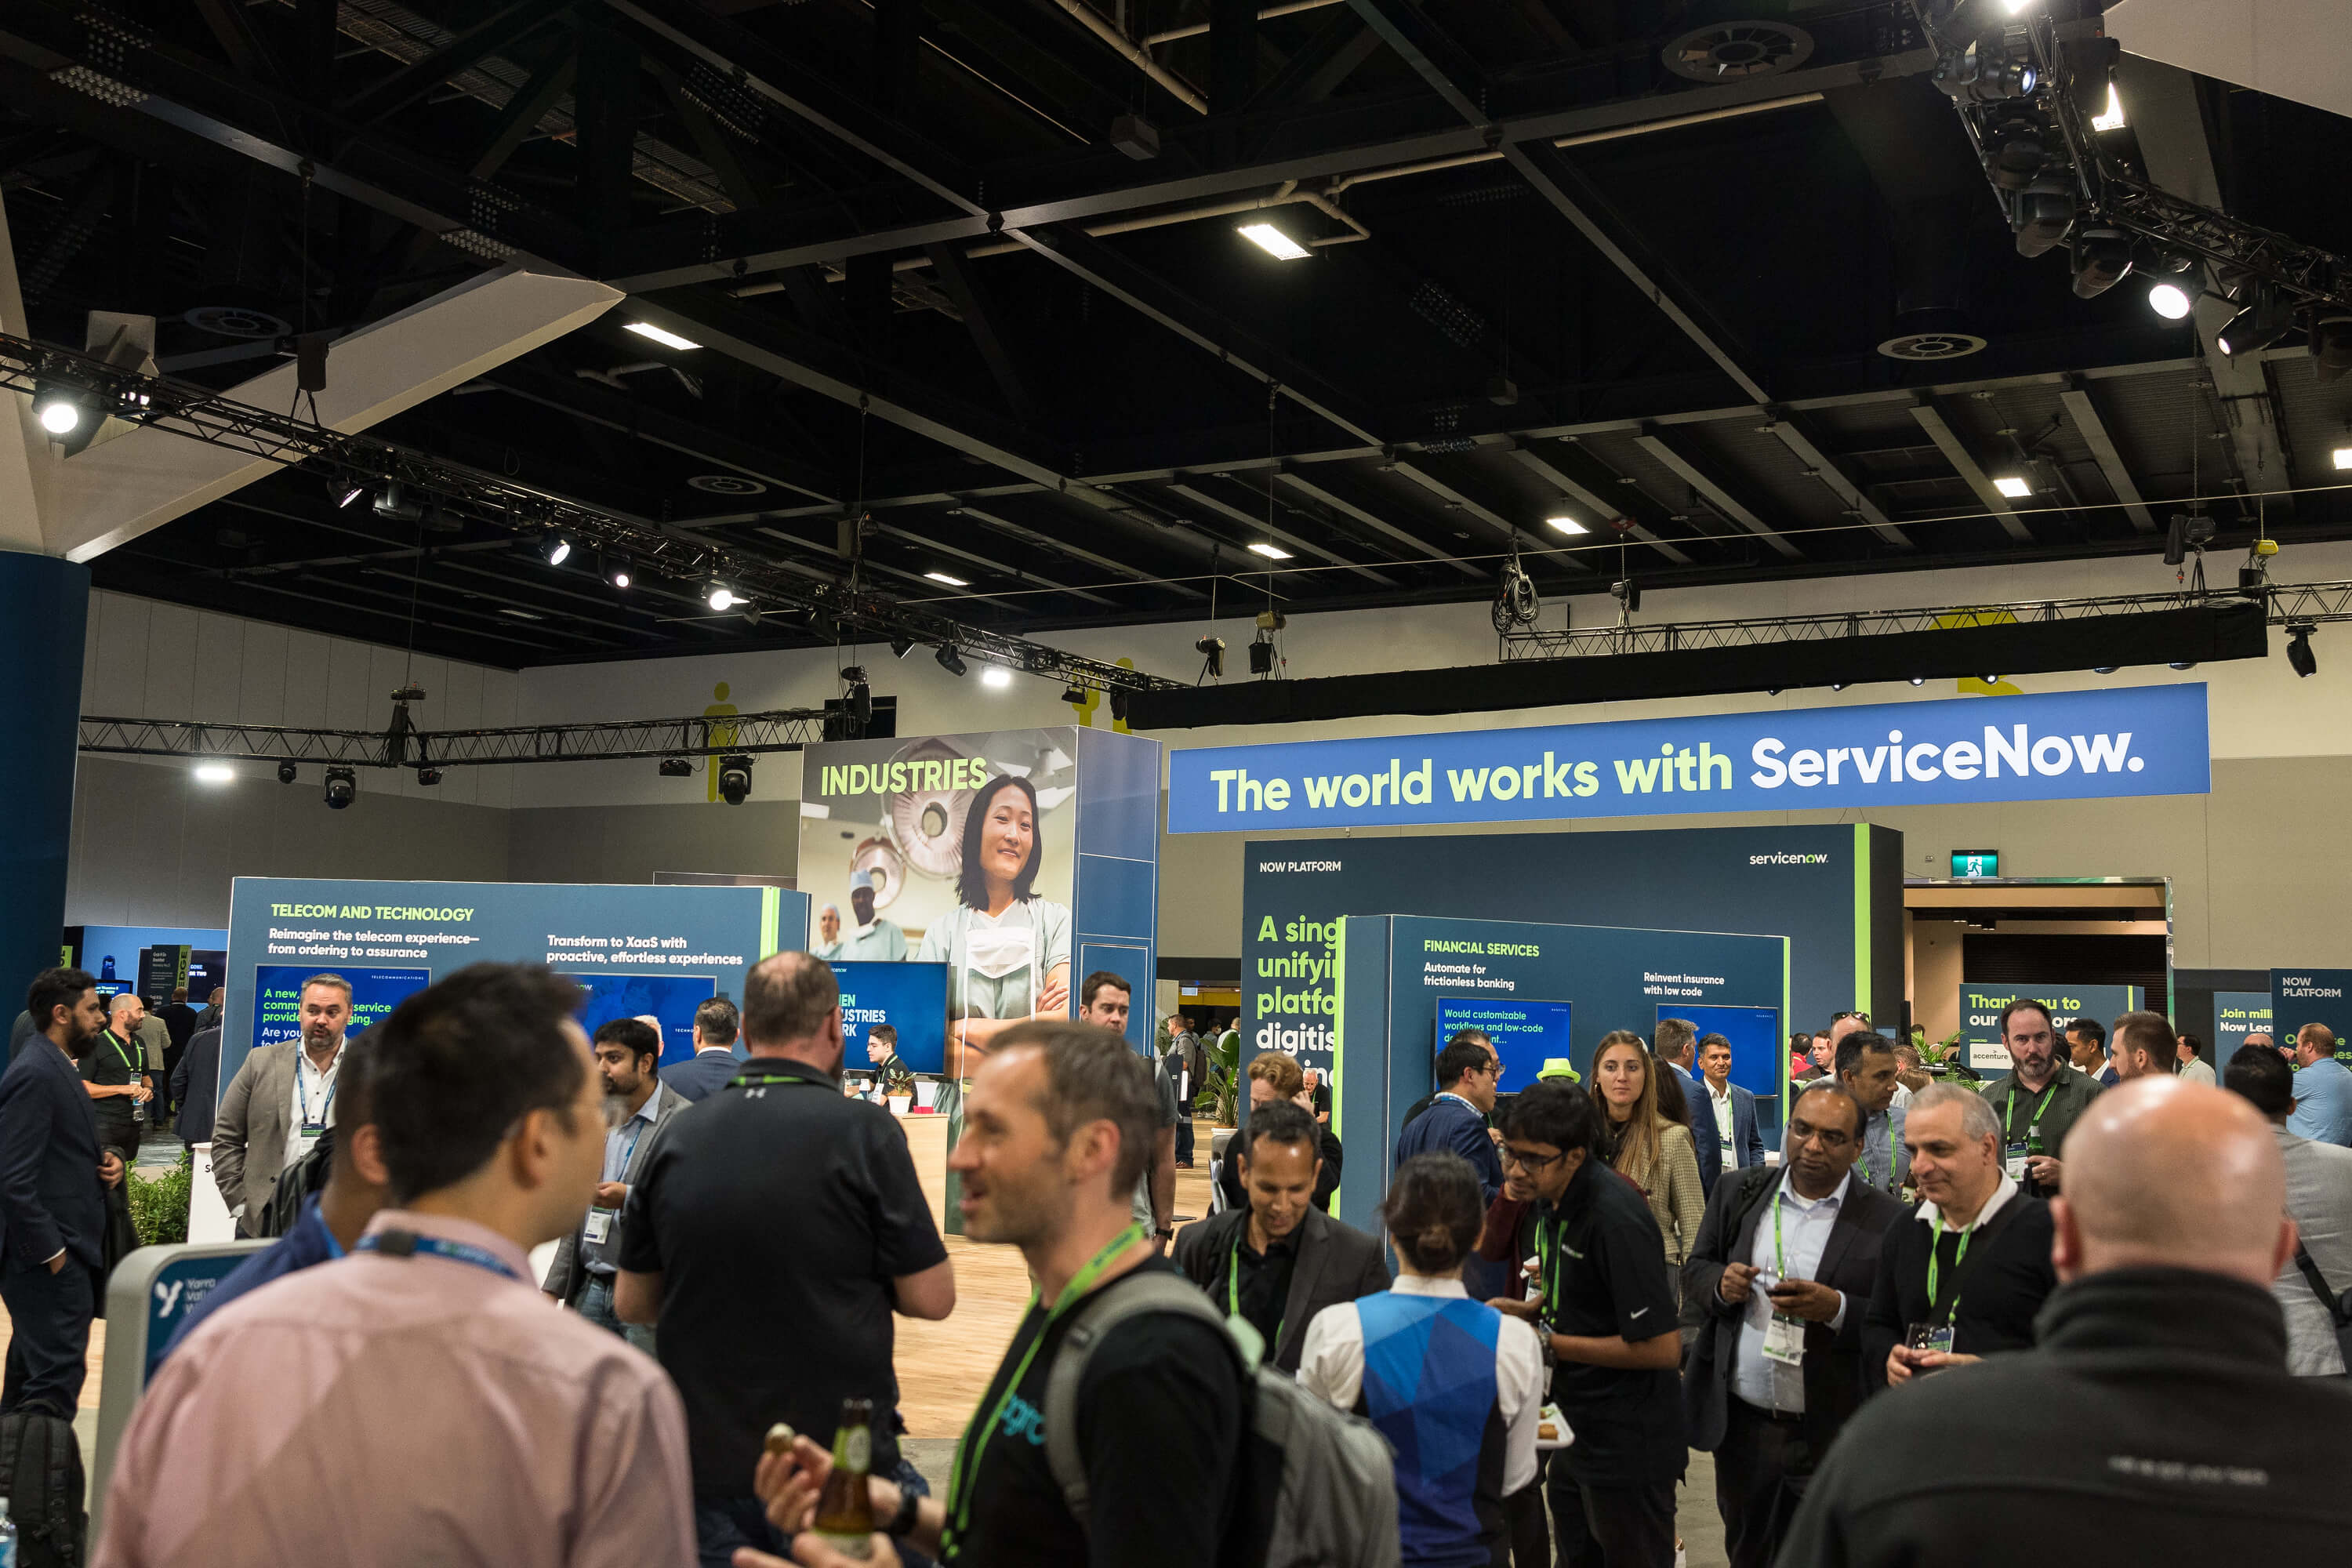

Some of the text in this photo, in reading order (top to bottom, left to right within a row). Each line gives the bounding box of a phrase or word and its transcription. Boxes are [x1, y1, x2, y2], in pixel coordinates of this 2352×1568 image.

[1210, 724, 2145, 813] The world works with ServiceNow.
[820, 757, 987, 796] INDUSTRIES
[1749, 851, 1828, 865] servicenow
[1259, 861, 1342, 873] NOW PLATFORM
[270, 903, 474, 921] TELECOM AND TECHNOLOGY
[269, 927, 330, 942] Reimagine
[332, 930, 352, 942] the
[355, 931, 403, 943] telecom
[1258, 915, 1279, 942] A
[546, 935, 688, 949] Transform to XaaS with
[1424, 939, 1540, 957] FINANCIAL SERVICES
[268, 943, 428, 958] from ordering to assurance
[546, 951, 743, 966] proactive, effortless experiences
[1424, 962, 1486, 975] Automate for
[1424, 975, 1515, 991] frictionless banking
[1644, 972, 1725, 985] Reinvent insurance
[2282, 977, 2311, 985] NOW
[263, 989, 273, 998] A
[1643, 985, 1703, 996] with low code
[2283, 988, 2342, 997] PLATFORM
[353, 1003, 392, 1013] service
[2062, 996, 2082, 1011] to
[1444, 1009, 1526, 1020] Would customizable
[2220, 1008, 2246, 1018] Join
[1969, 1014, 1998, 1026] our
[262, 1027, 281, 1036] Are
[1444, 1022, 1544, 1033] workflows and low-code
[2220, 1022, 2246, 1032] Now
